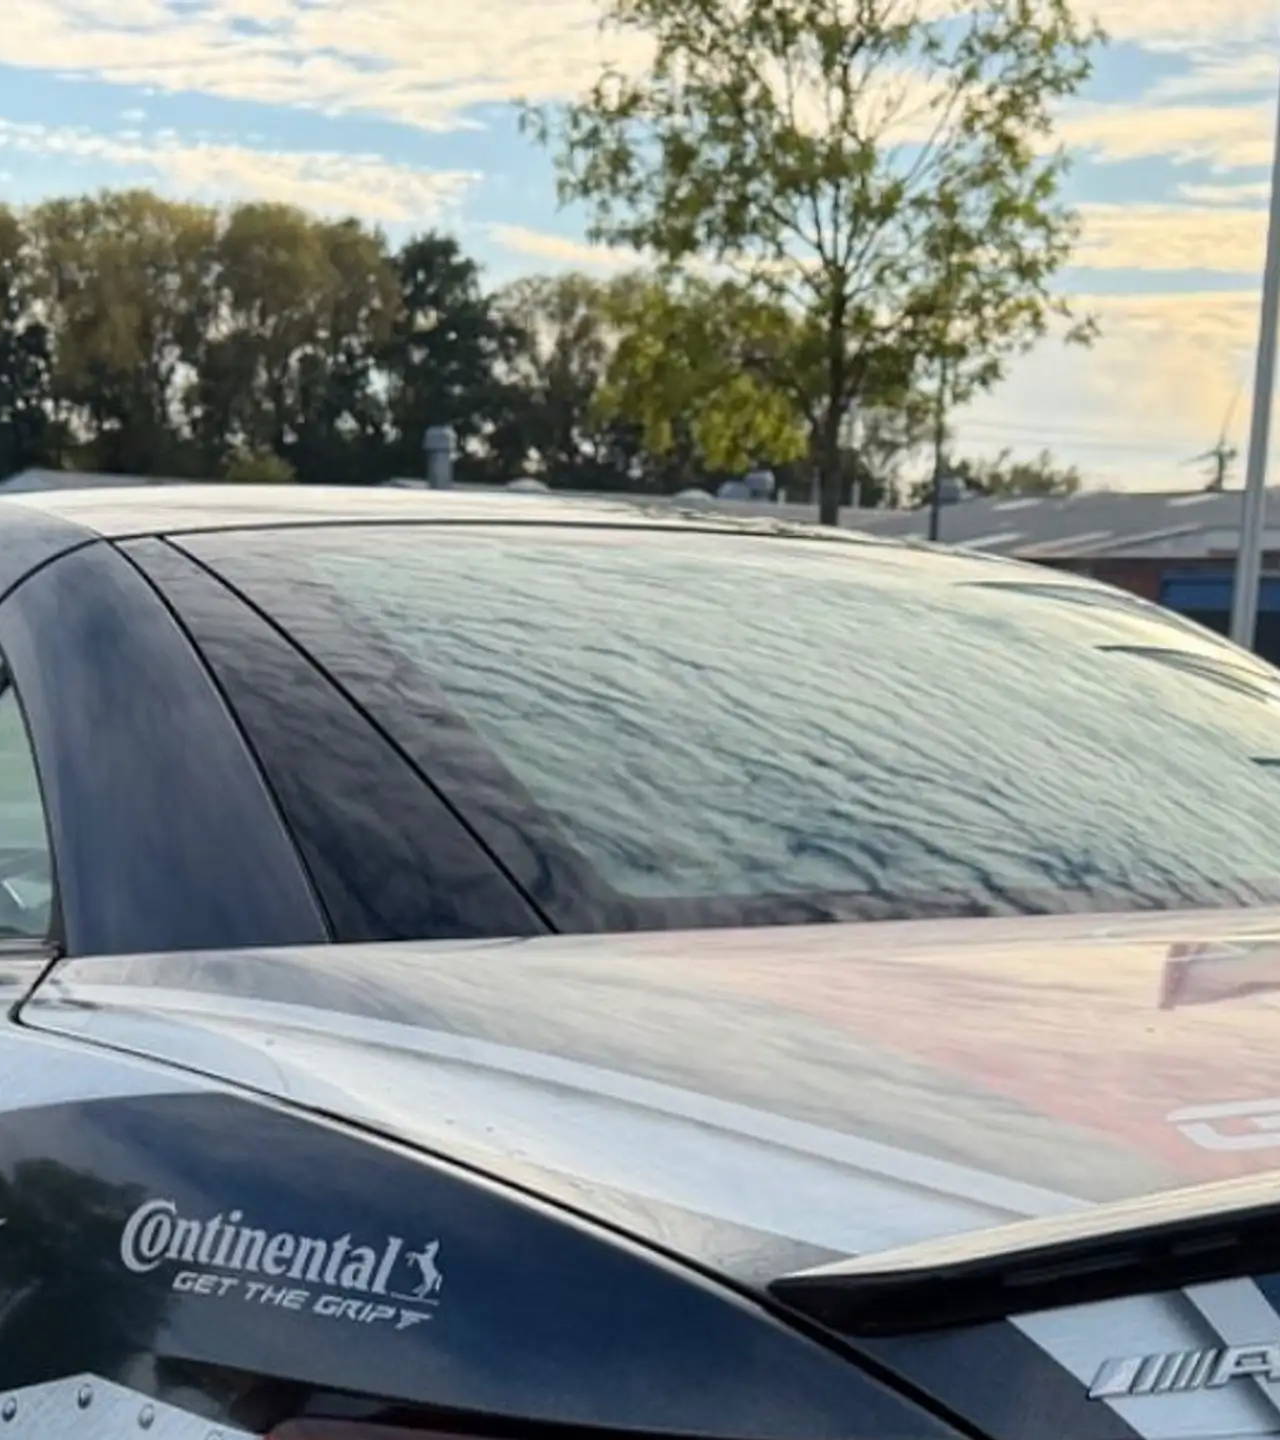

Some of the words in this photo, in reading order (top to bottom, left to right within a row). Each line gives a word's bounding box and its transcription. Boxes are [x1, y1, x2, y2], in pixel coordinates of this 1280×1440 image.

[122, 1199, 403, 1294] Continental
[172, 1271, 240, 1297] GET
[244, 1281, 311, 1310] THE
[312, 1294, 400, 1324] GRIP
